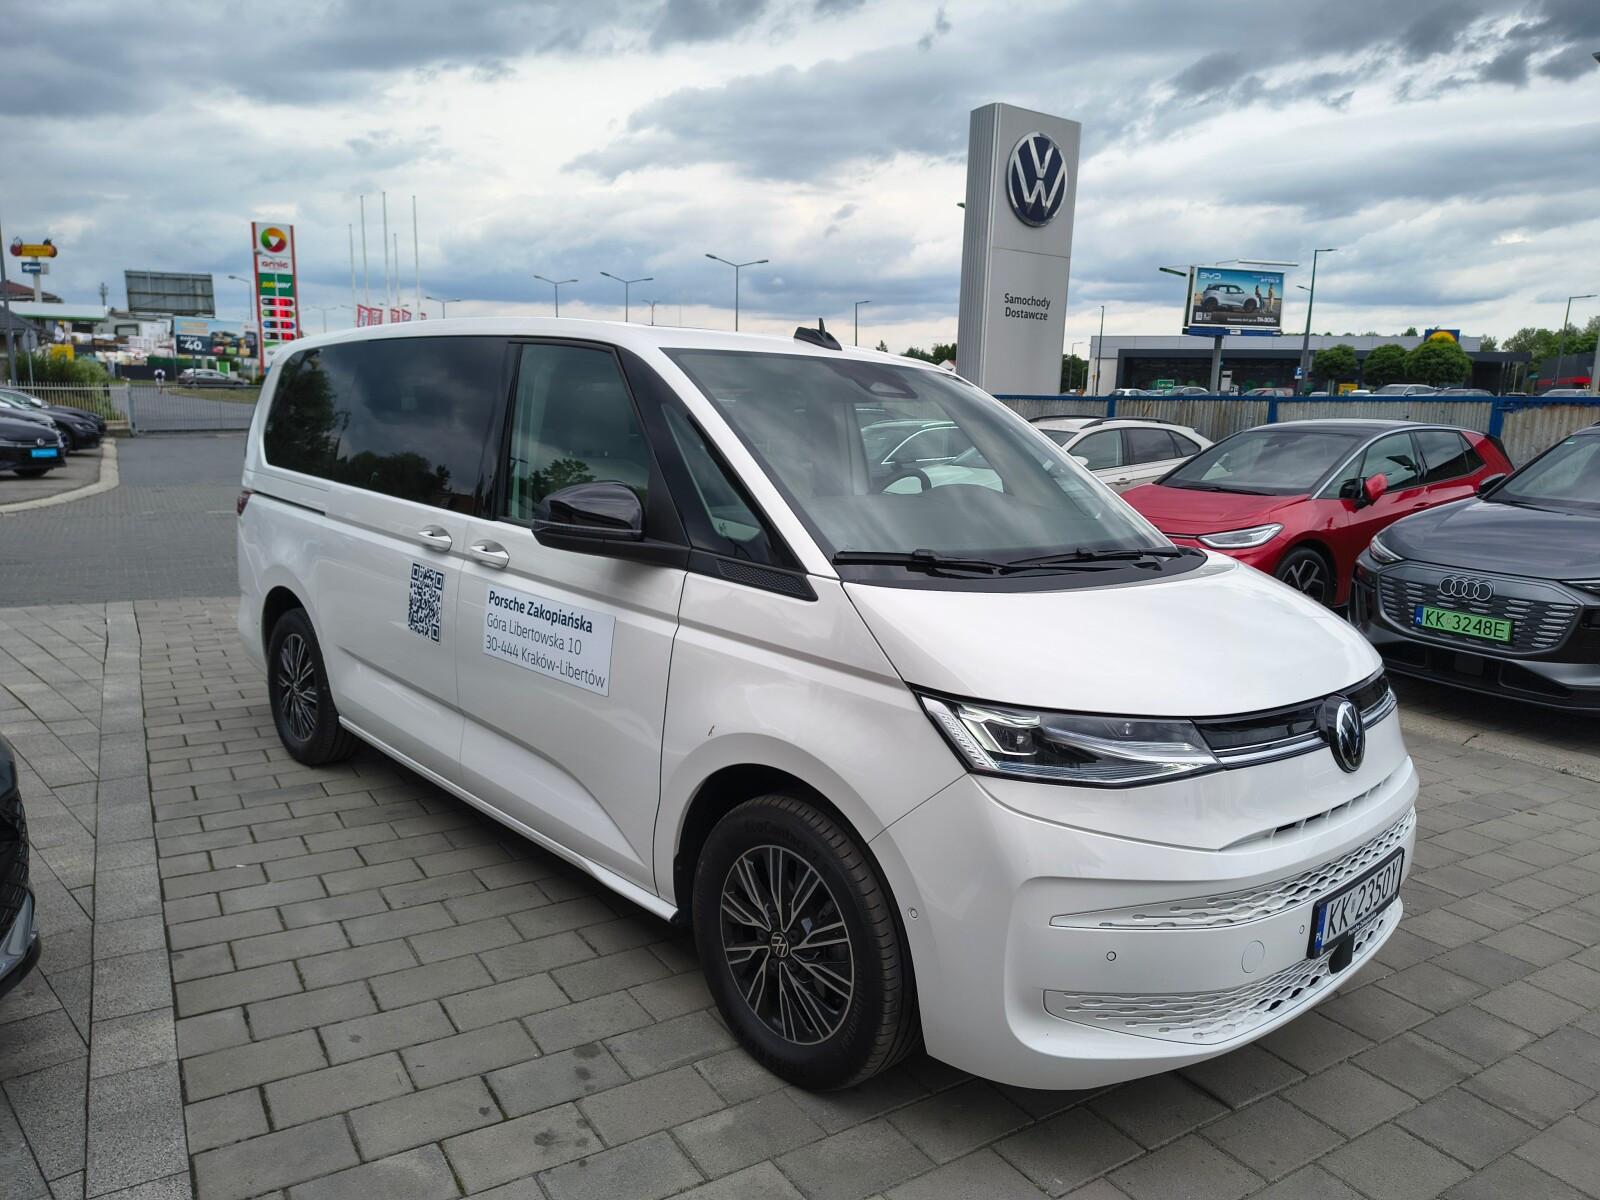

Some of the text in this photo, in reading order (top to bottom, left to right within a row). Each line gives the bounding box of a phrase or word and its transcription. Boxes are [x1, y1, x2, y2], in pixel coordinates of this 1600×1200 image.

[1199, 272, 1222, 280] BYD
[1004, 292, 1051, 310] Samochody
[1005, 306, 1049, 321] Dostawcze
[488, 590, 593, 634] Porsche Zakopiańska
[1425, 609, 1506, 639] KK 3248E
[486, 612, 582, 655] Góra Libertowska 10
[486, 634, 606, 688] 30-444 Kraków-Libertów
[1327, 857, 1400, 940] KK 2350Y
